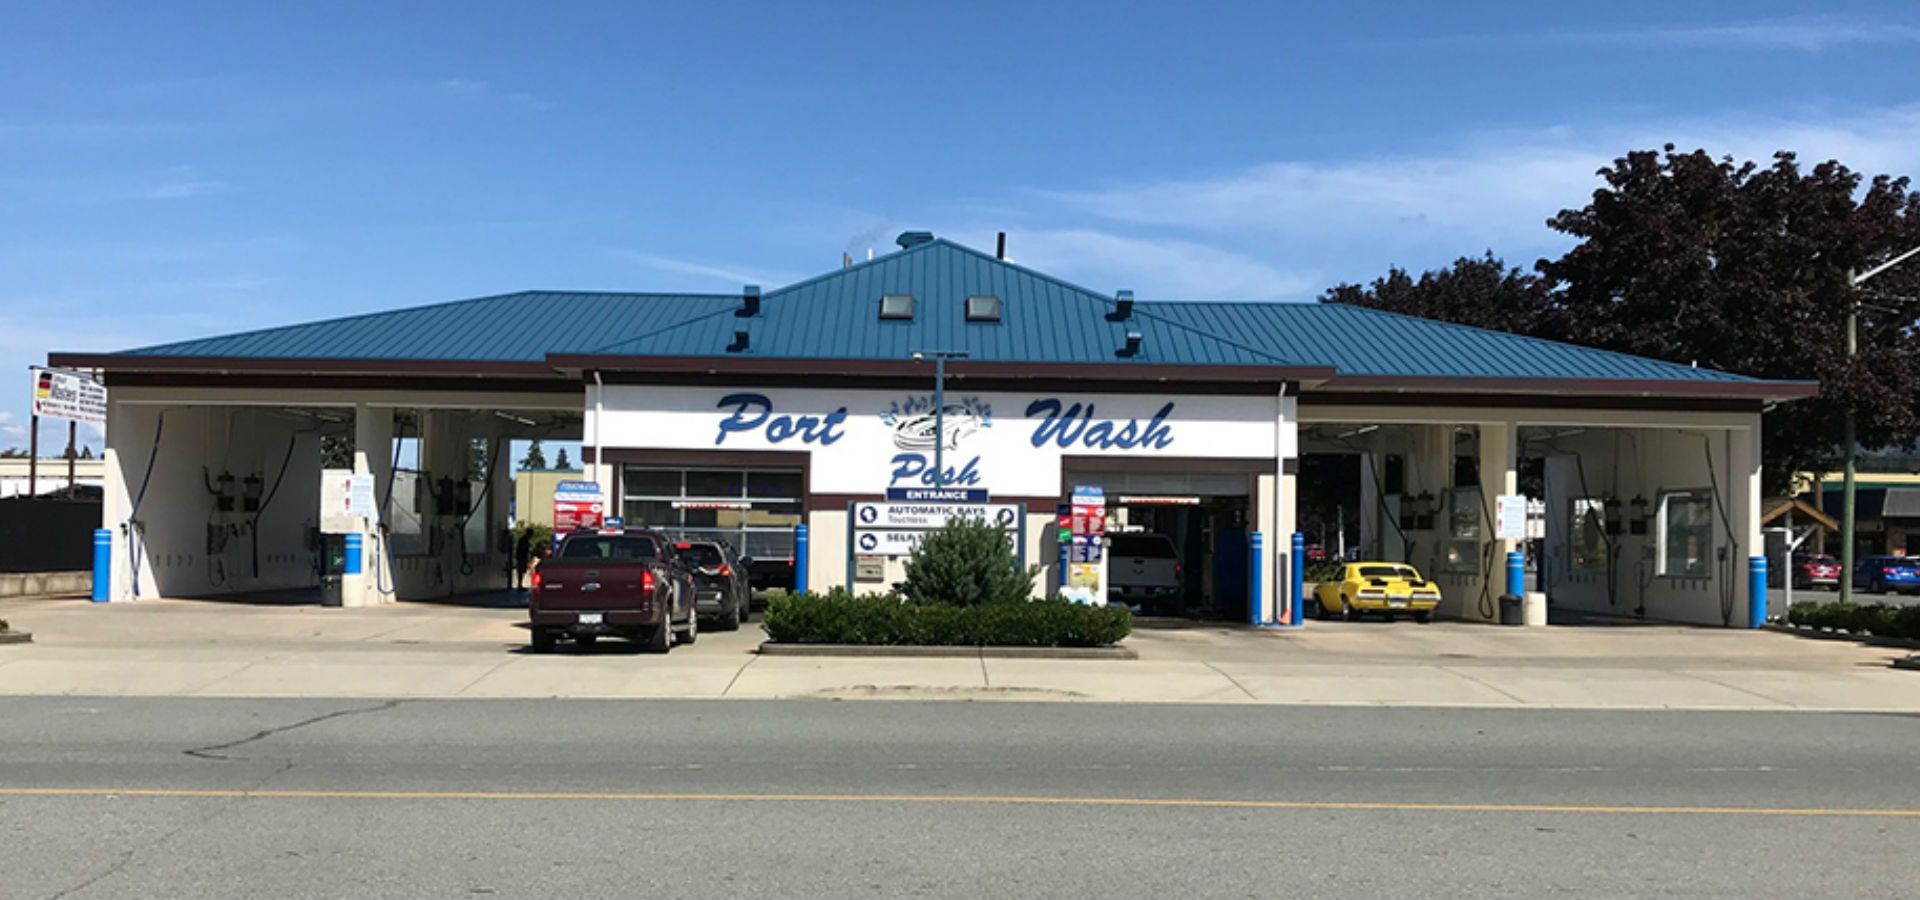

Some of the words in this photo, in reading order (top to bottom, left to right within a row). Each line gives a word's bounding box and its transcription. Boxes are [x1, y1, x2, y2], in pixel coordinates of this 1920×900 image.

[715, 392, 848, 445] Port
[1025, 398, 1174, 449] Wash
[890, 453, 981, 486] Posh
[888, 506, 954, 515] AUTOMATIC
[957, 507, 986, 515] BAYS
[906, 490, 968, 500] ENTRANCE
